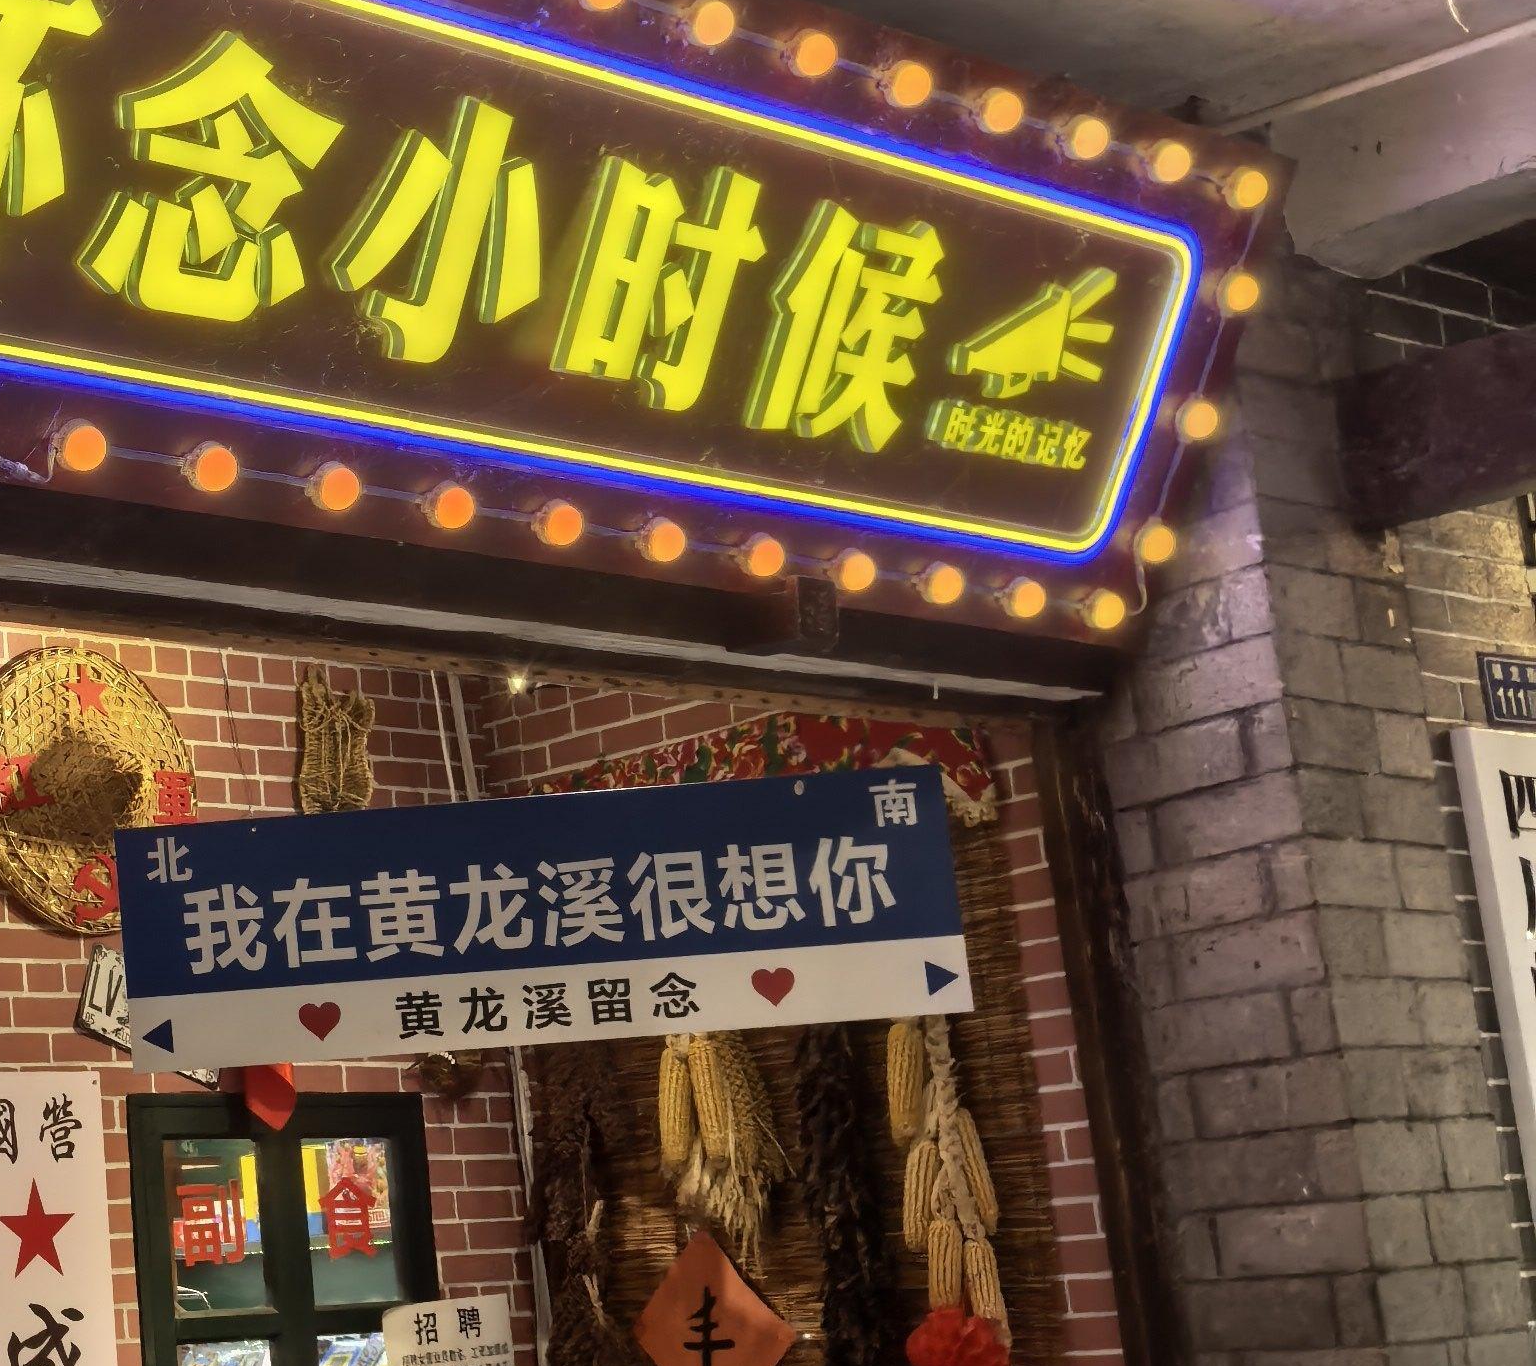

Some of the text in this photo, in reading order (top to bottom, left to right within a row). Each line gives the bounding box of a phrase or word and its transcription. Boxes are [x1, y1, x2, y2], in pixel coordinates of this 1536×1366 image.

[932, 399, 1092, 470] 时光的记忆
[868, 778, 918, 829] 南
[147, 836, 193, 884] 北
[183, 836, 898, 977] 我在黄龙溪很想你
[394, 972, 703, 1041] 黄龙溪留念
[176, 1176, 378, 1267] 副食
[413, 1306, 483, 1346] 招聘
